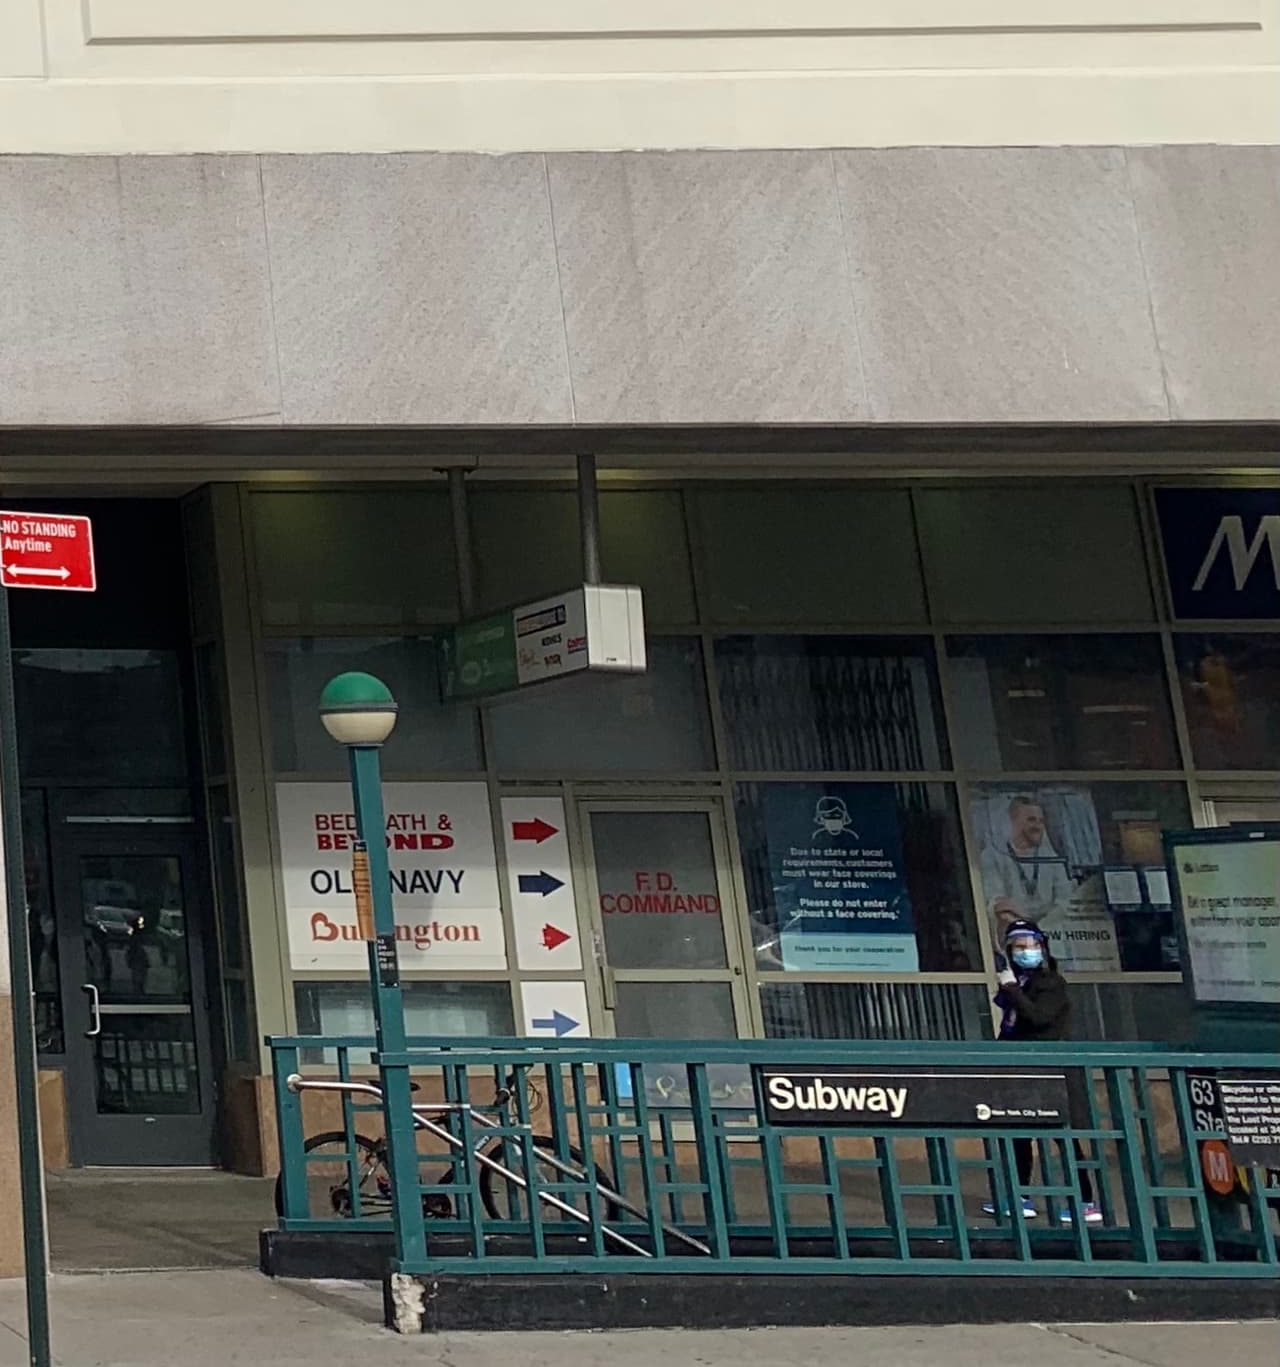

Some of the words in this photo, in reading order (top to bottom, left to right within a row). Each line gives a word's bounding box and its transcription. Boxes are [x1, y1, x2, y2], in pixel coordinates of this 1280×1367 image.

[2, 520, 20, 535] NO
[21, 521, 77, 538] STANDING
[5, 536, 53, 554] Anytime
[386, 814, 426, 831] ATH
[437, 813, 453, 831] &
[790, 847, 808, 857] Due
[811, 848, 820, 856] to
[823, 848, 847, 857] state
[849, 849, 859, 857] or
[861, 848, 884, 857] local
[310, 869, 354, 895] OL
[390, 869, 465, 894] NAVY
[782, 869, 806, 878] must
[808, 870, 831, 878] wear
[833, 868, 851, 878] face
[854, 869, 897, 880] coverings
[824, 881, 840, 889] our
[842, 880, 870, 889] store.
[600, 894, 720, 913] COMMAND
[799, 897, 829, 908] Please
[831, 898, 843, 908] do
[845, 898, 861, 908] not
[863, 899, 888, 908] enter
[790, 909, 825, 918] without
[835, 909, 855, 919] face
[310, 912, 481, 951] Bungton
[1064, 930, 1112, 942] HIRING
[768, 1076, 908, 1119] Subway
[1190, 1078, 1215, 1106] 63
[1195, 1109, 1225, 1132] Sta
[1241, 1115, 1261, 1124] Lost
[1208, 1149, 1229, 1182] M
